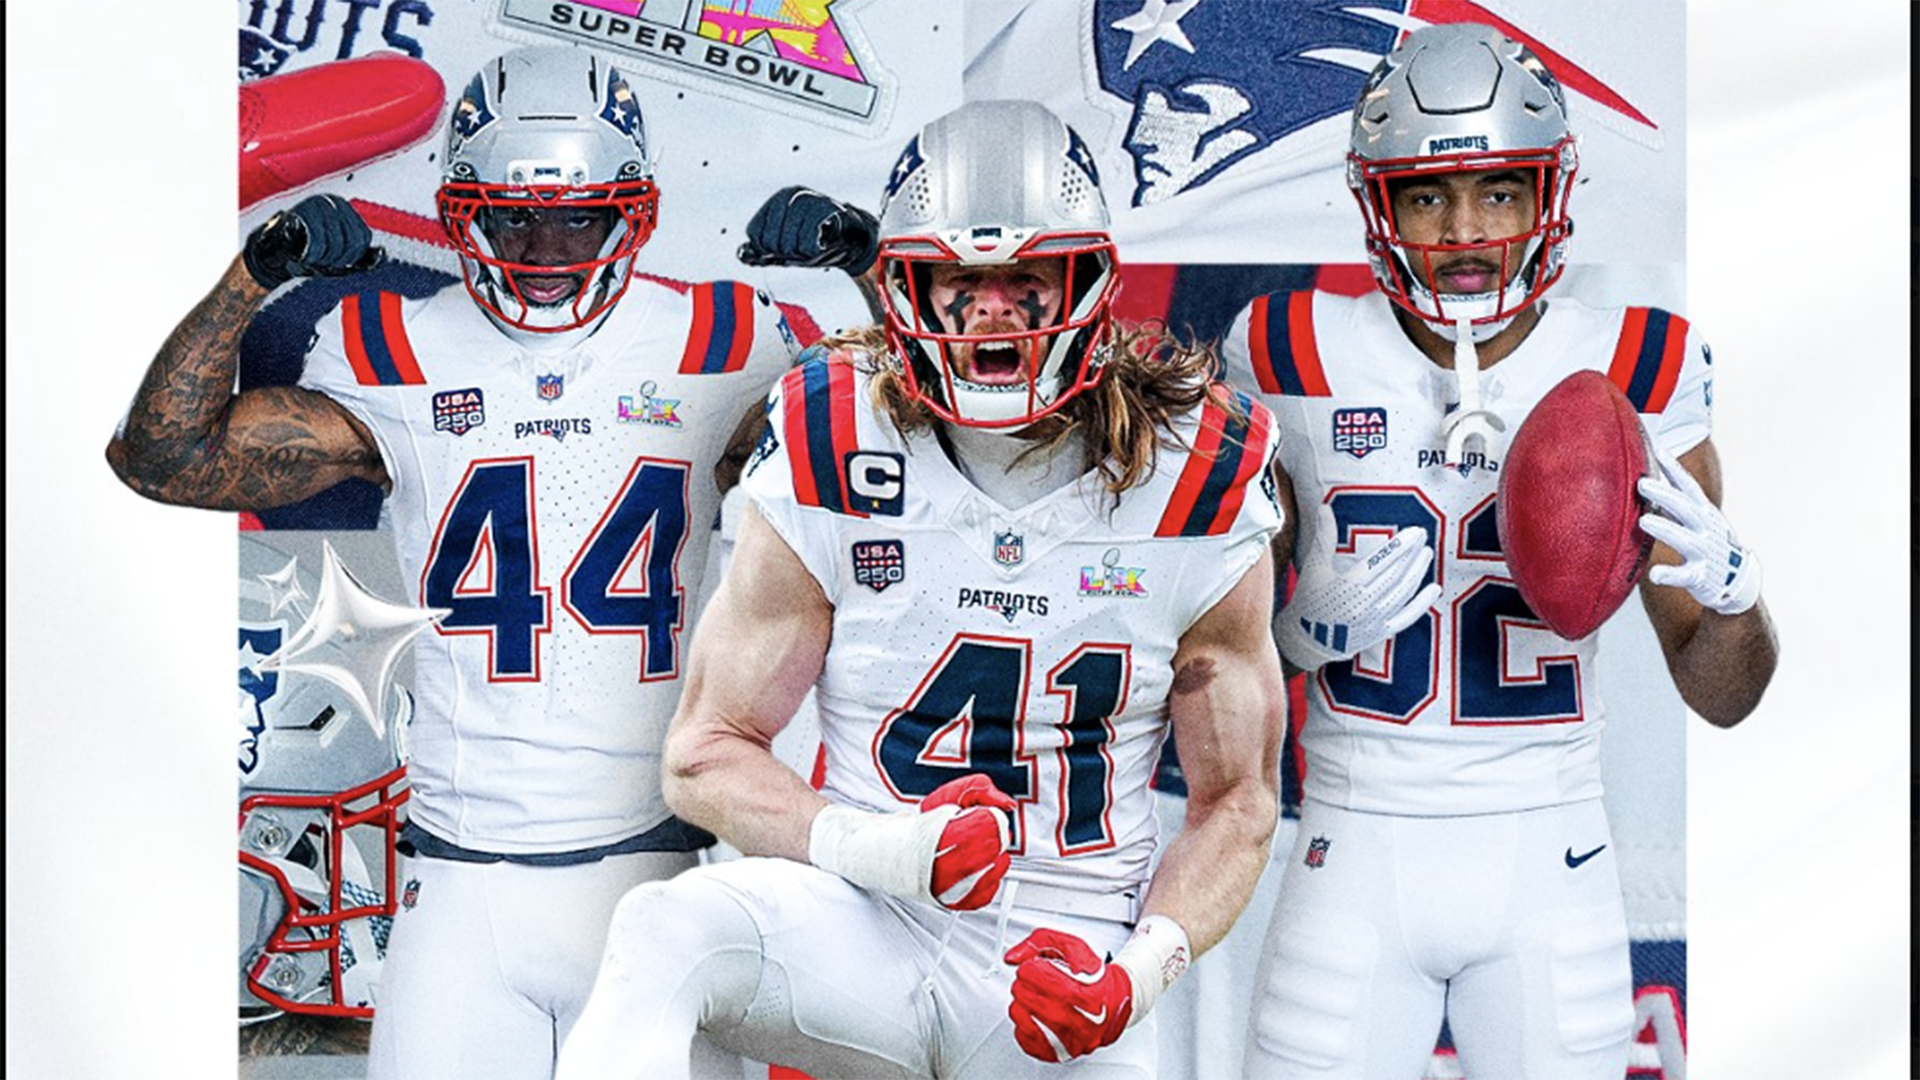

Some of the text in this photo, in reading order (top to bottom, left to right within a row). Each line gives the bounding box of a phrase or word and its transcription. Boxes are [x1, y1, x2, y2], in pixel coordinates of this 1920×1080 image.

[550, 3, 687, 55] SUPER
[704, 46, 825, 97] BOWL
[1428, 134, 1489, 156] PATRIOTS
[436, 392, 480, 408] USA
[436, 411, 483, 430] 250
[514, 417, 592, 440] PATRIOTS
[1336, 412, 1383, 426] USA
[1335, 434, 1386, 450] 250
[1417, 449, 1499, 473] PATIOTS
[850, 454, 901, 500] C
[855, 545, 900, 559] USA
[997, 546, 1020, 562] NFL
[420, 455, 692, 683] 44
[856, 567, 902, 583] 250
[957, 587, 1050, 616] PATRIOTS
[1317, 485, 1584, 726] 32
[871, 632, 1132, 857] 41
